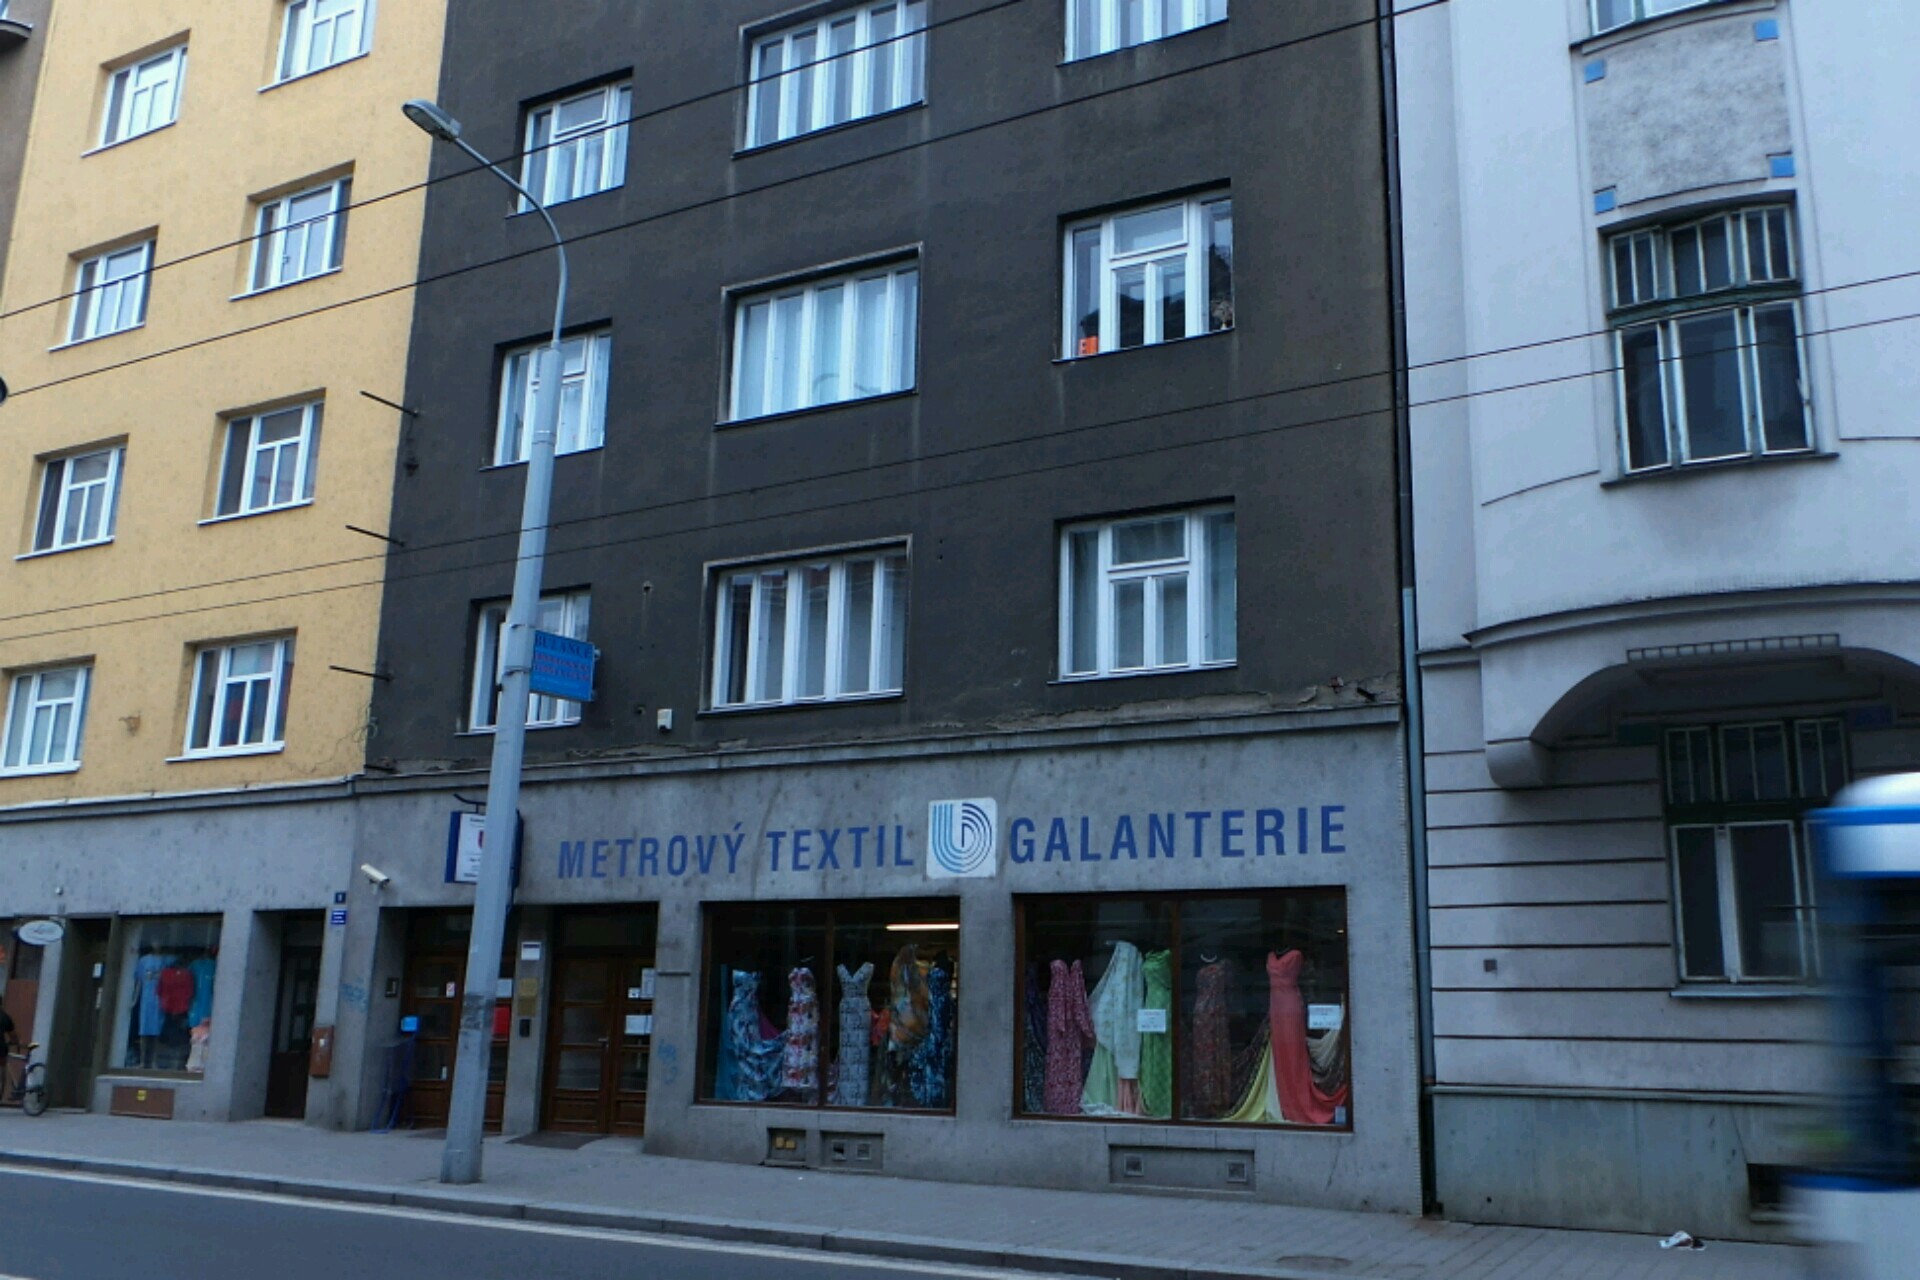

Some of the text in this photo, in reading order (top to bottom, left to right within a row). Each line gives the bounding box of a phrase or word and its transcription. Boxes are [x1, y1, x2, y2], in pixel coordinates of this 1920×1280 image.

[557, 805, 1346, 879] METROVÝ TEXTIL GALANTERIE
